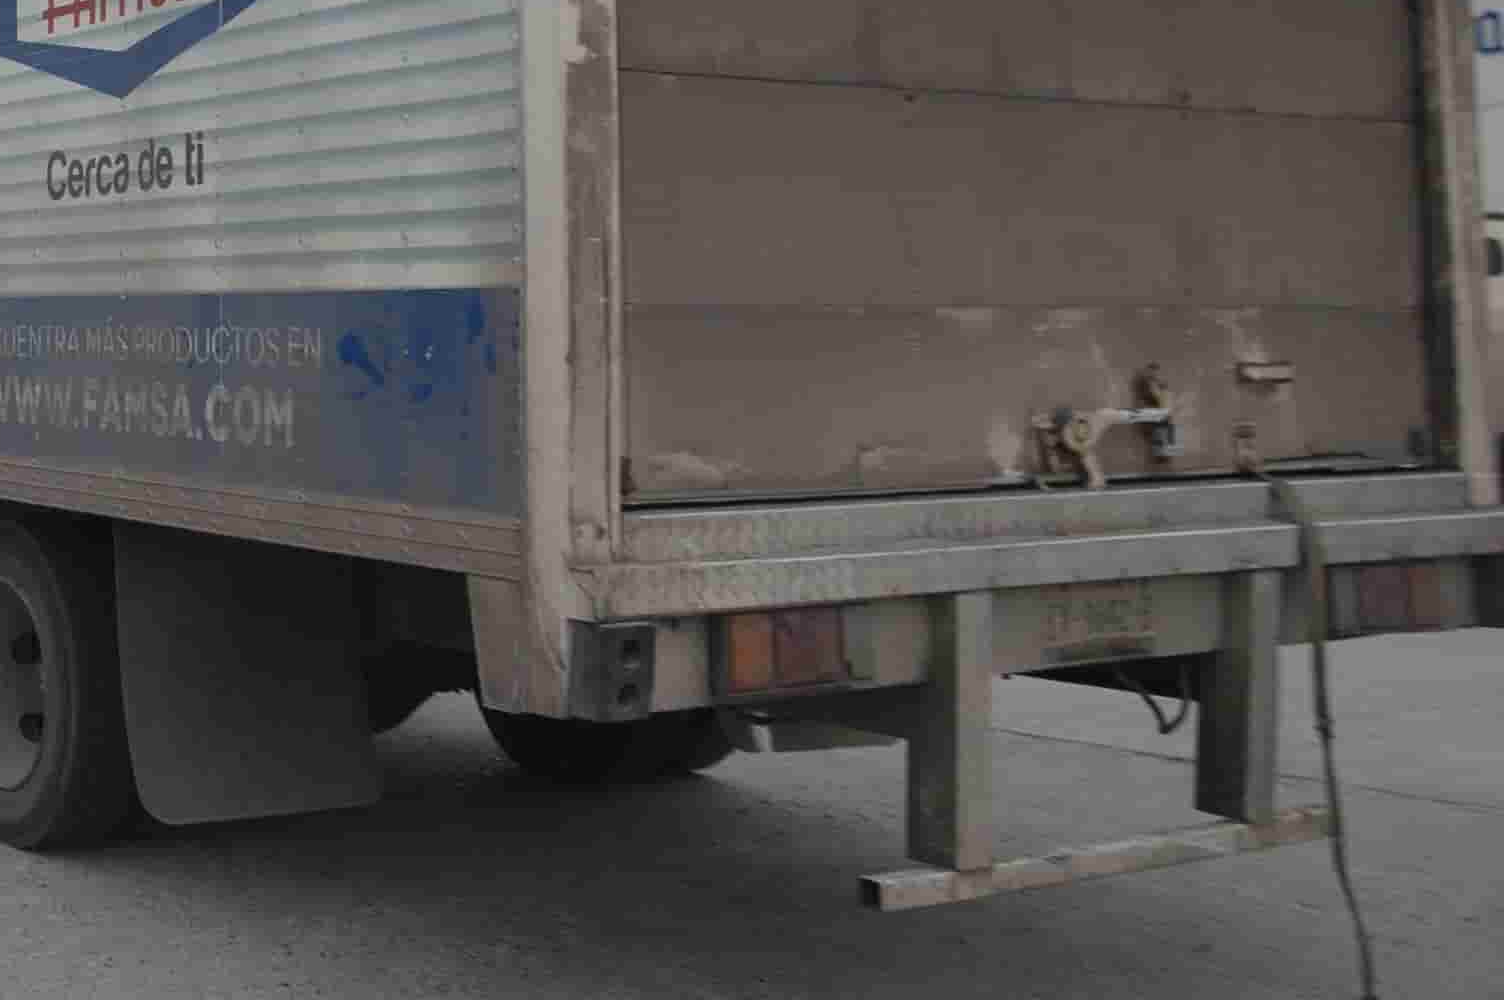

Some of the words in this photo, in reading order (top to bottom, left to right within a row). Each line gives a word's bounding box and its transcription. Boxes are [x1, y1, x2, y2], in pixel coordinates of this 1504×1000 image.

[46, 148, 130, 201] Cerca
[137, 139, 174, 192] de
[183, 130, 205, 186] ti
[134, 325, 281, 368] PRODUCTOS
[287, 327, 322, 369] EN
